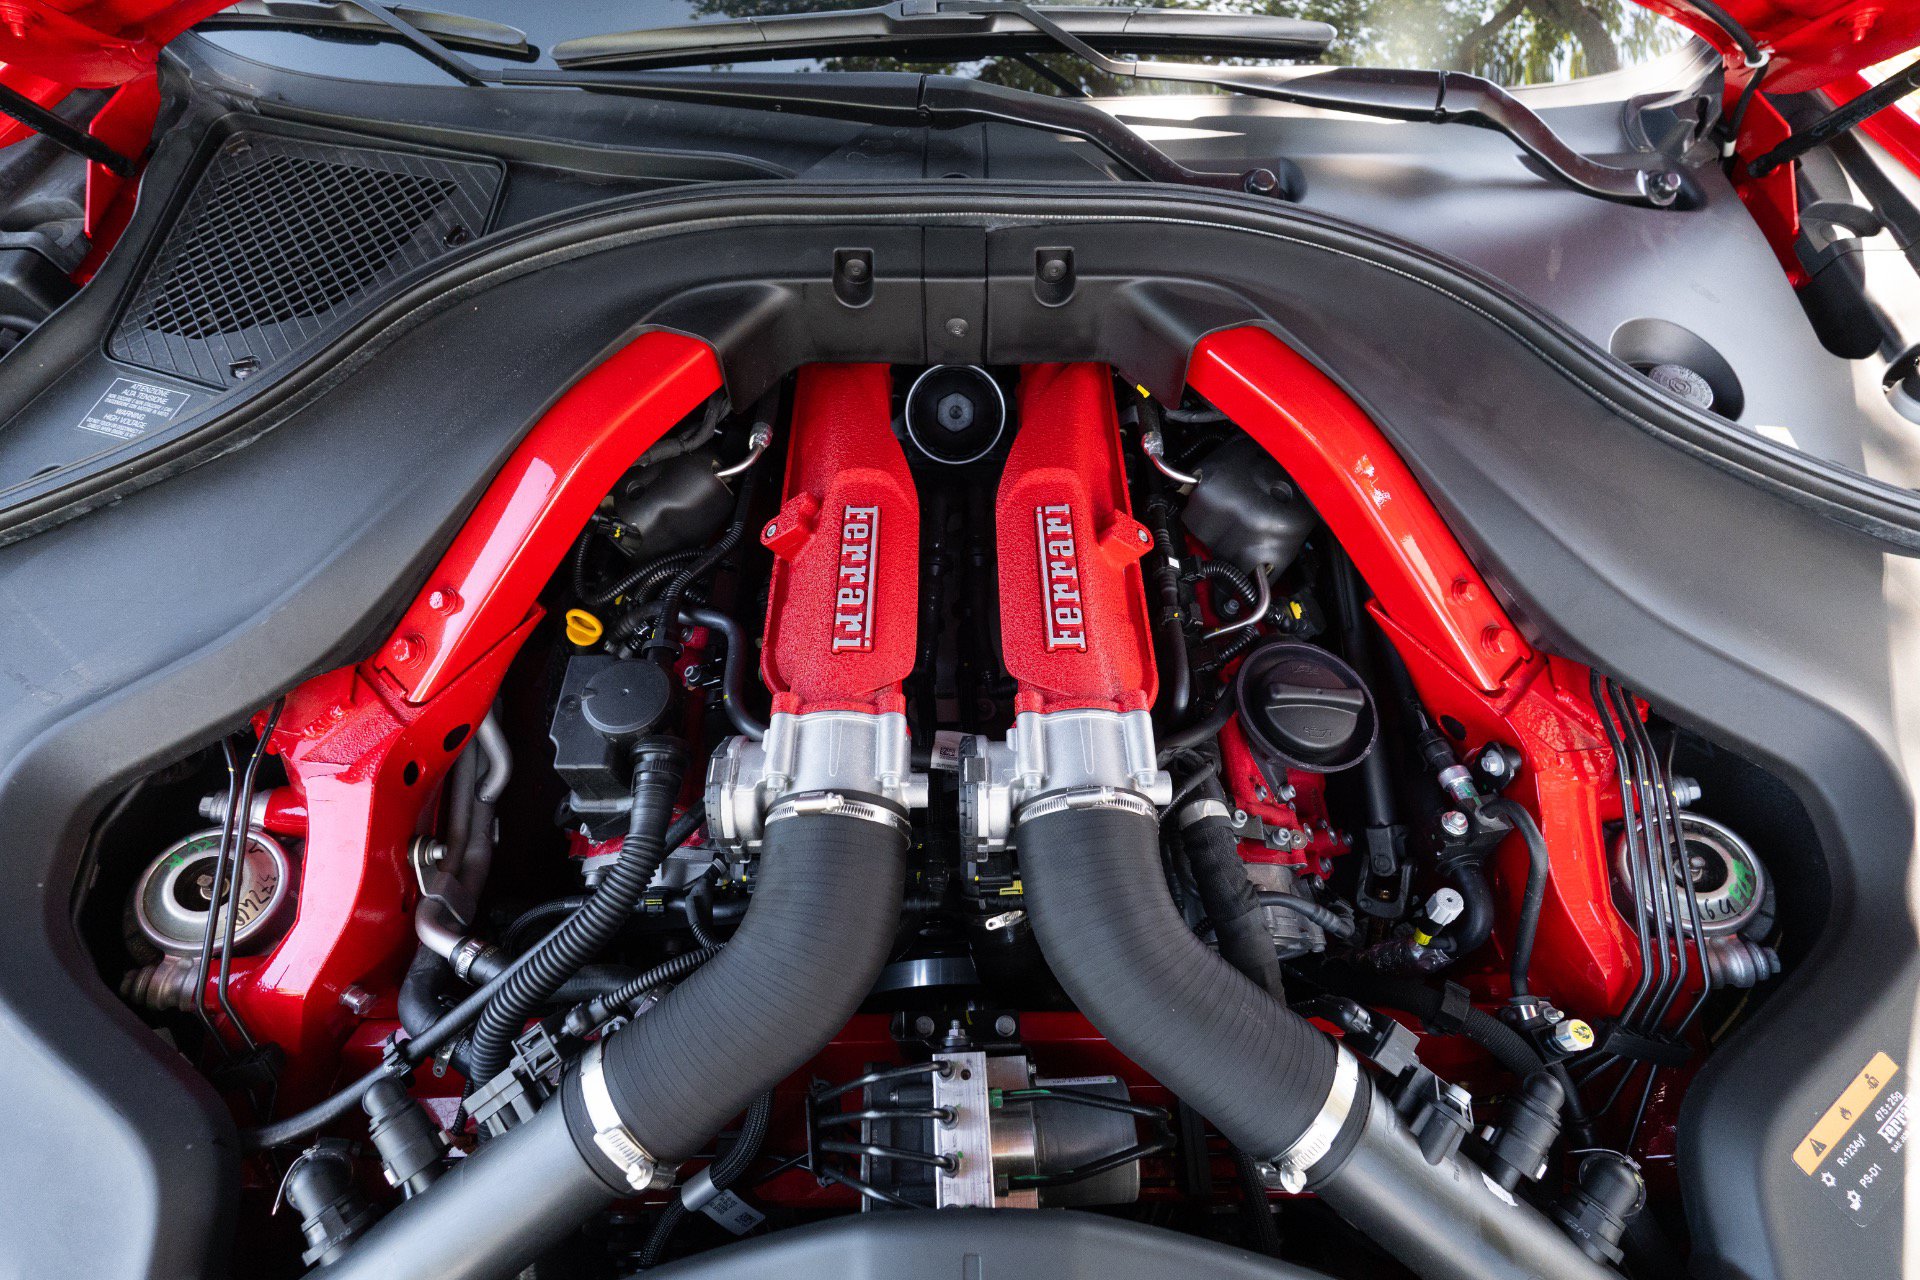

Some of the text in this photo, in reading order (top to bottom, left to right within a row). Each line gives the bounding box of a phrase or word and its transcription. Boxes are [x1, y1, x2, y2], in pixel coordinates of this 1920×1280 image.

[121, 389, 137, 397] ALTA
[136, 392, 168, 404] TENSIONE
[130, 383, 169, 397] ATTENZIONE
[103, 413, 120, 422] HIGH
[119, 417, 147, 429] VOLTAGE
[115, 408, 146, 420] WARNING
[832, 505, 879, 650] Ferrari
[1034, 503, 1086, 649] Ferrari
[1836, 1133, 1866, 1168] R-1234yf
[1858, 1163, 1883, 1189] PS-D1
